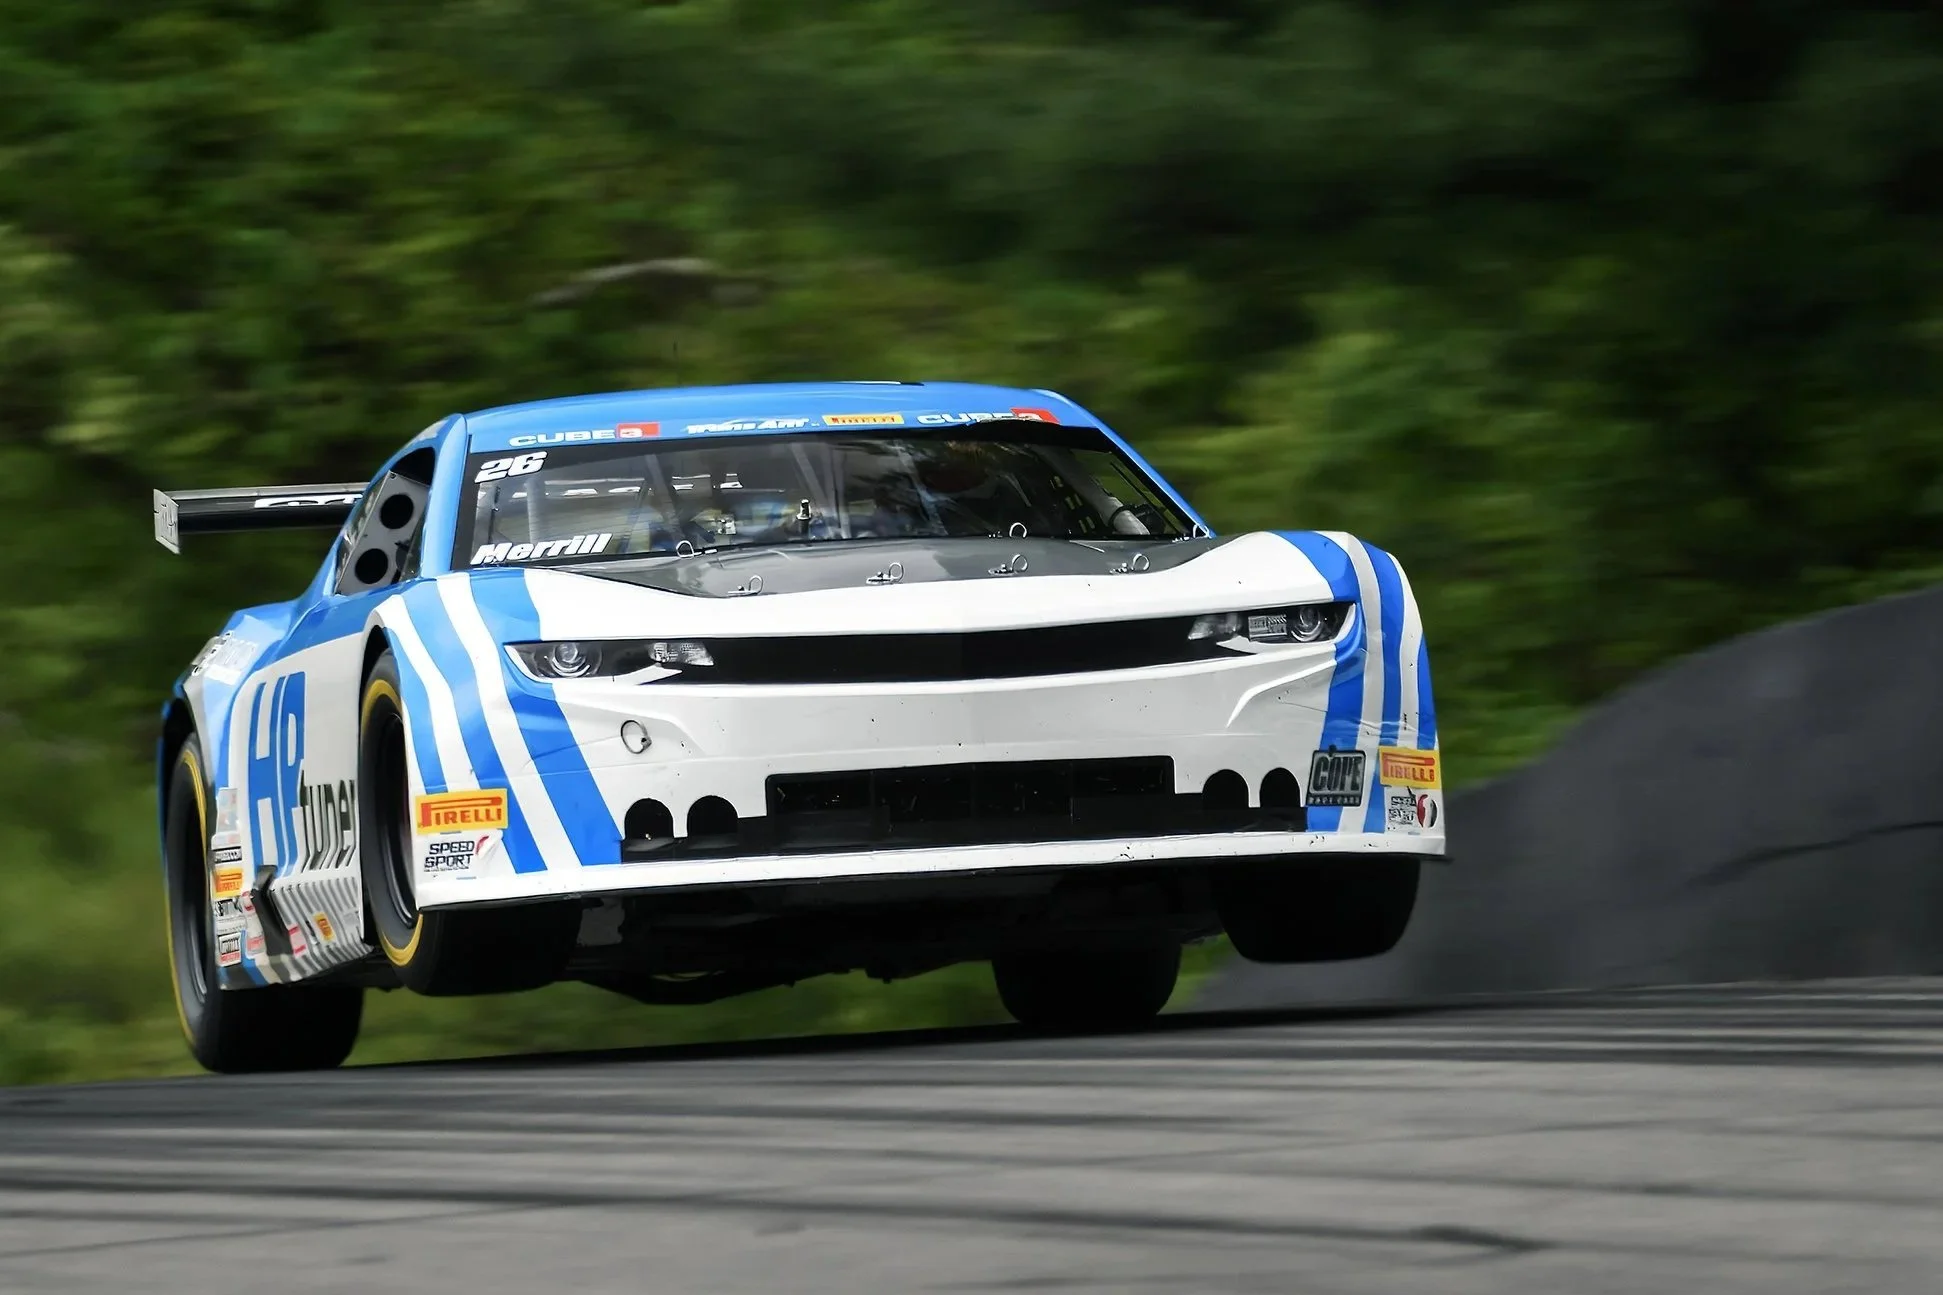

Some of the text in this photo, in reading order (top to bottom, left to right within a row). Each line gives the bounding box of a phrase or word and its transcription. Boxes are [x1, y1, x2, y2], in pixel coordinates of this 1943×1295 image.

[475, 451, 547, 483] 26
[470, 533, 612, 565] Merrill
[248, 671, 306, 878] HP
[1312, 756, 1363, 792] COPE
[1383, 752, 1436, 783] PIRELLI
[418, 796, 503, 828] PIRELLI
[424, 853, 474, 868] SPORT
[429, 840, 475, 856] SPEED
